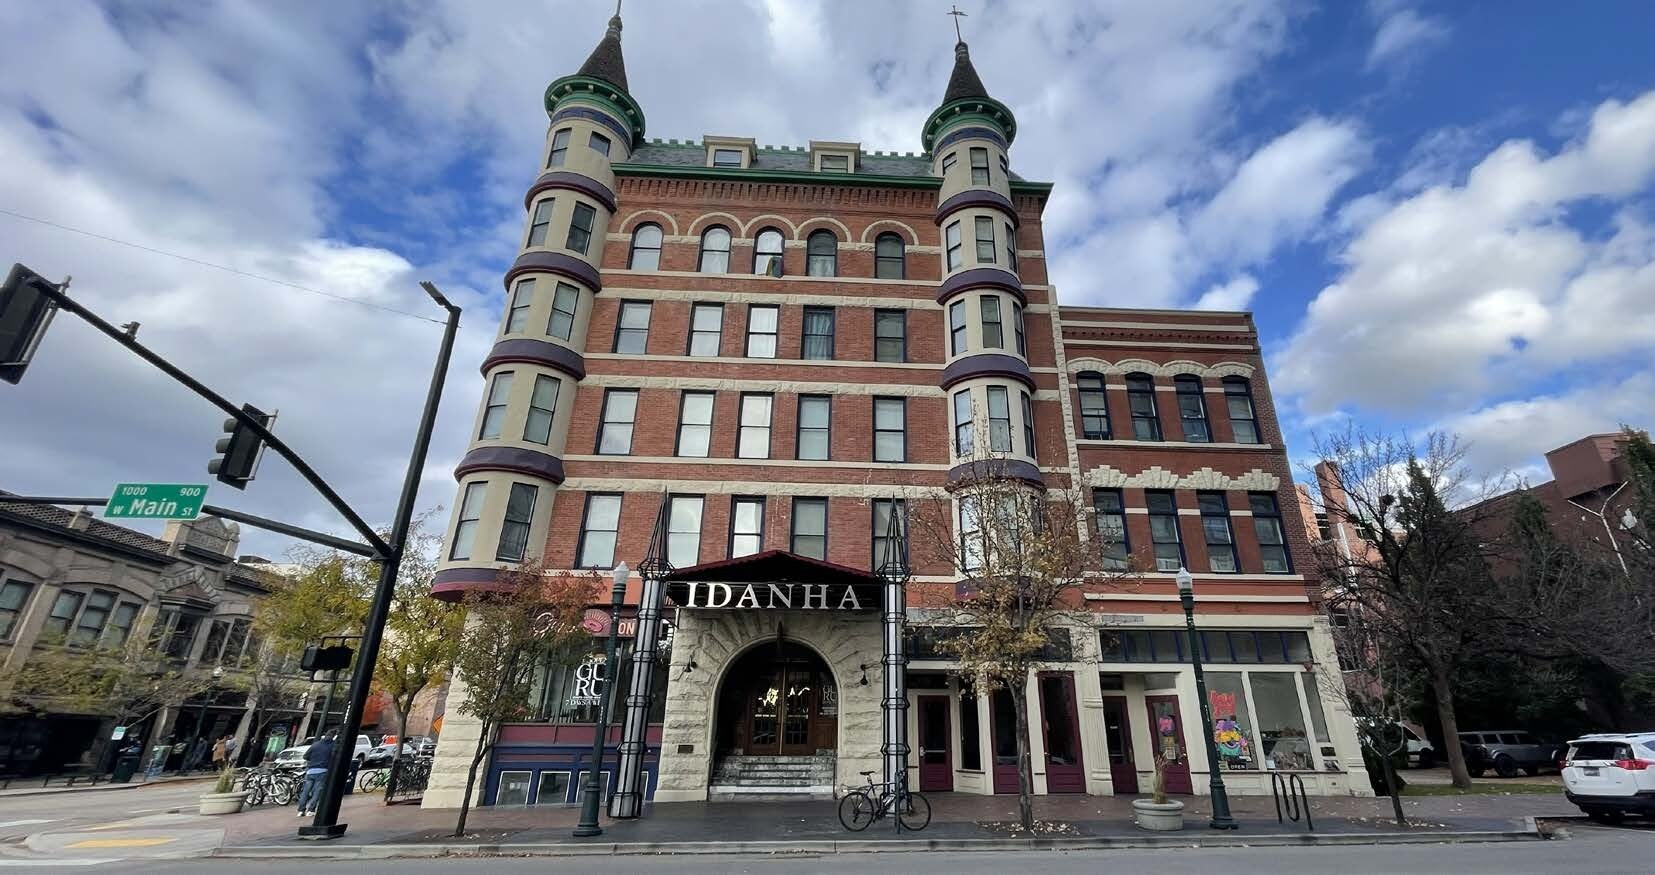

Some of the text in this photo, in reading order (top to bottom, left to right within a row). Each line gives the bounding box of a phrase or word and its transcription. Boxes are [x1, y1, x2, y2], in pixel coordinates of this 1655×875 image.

[122, 487, 200, 496] 1000 900
[113, 498, 193, 516] W Main St
[686, 581, 863, 610] IDANHA
[618, 622, 635, 634] ON
